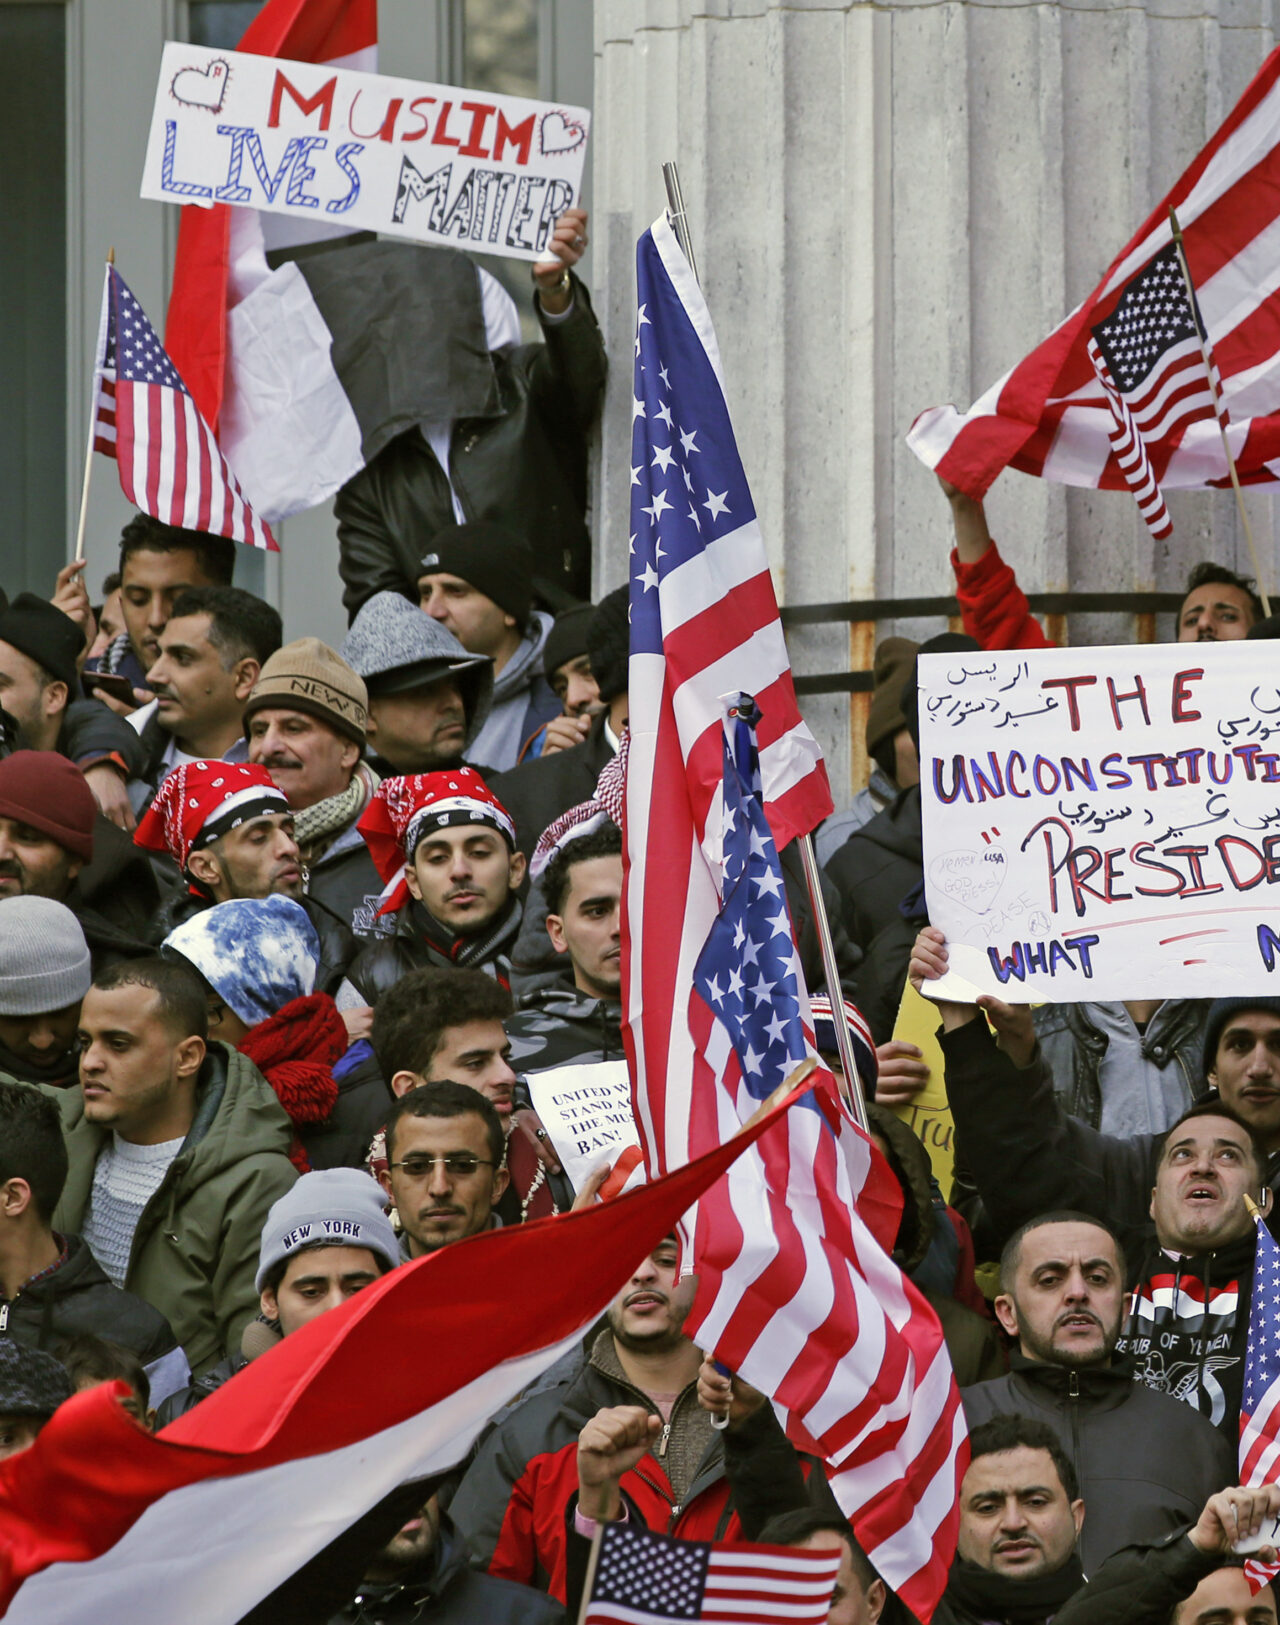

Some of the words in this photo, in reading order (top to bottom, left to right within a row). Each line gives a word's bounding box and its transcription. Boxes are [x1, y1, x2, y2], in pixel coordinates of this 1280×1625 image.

[267, 68, 537, 165] MUSLIM
[161, 119, 365, 214] LIVES
[392, 155, 574, 253] MATTER
[290, 679, 349, 712] NEW
[1042, 668, 1205, 731] THE
[987, 934, 1099, 984] WHAT
[552, 1087, 611, 1107] UNITED
[613, 1083, 630, 1095] W
[559, 1100, 613, 1121] STAND
[567, 1117, 603, 1136] THE
[605, 1113, 636, 1127] MUS
[901, 1103, 953, 1152] Tru
[576, 1129, 623, 1155] BAN!
[282, 1223, 312, 1251] NEW
[322, 1221, 361, 1238] YORK
[1160, 1332, 1181, 1350] OF
